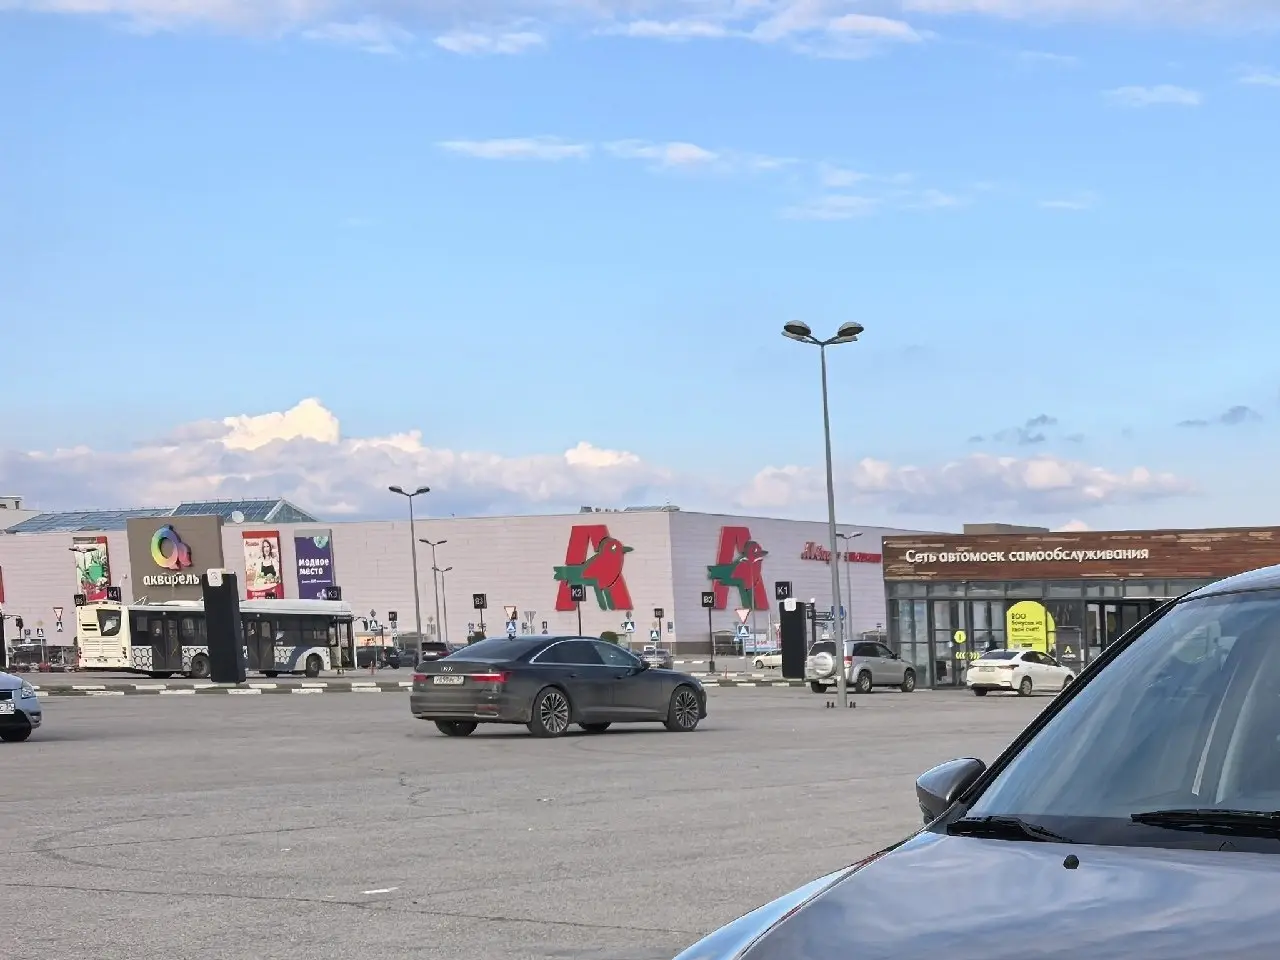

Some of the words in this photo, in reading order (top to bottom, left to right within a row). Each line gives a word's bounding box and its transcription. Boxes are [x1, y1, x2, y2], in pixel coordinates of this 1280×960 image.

[905, 549, 936, 563] Сеть
[938, 550, 1006, 562] автомоек
[1008, 547, 1150, 563] самообслуживания
